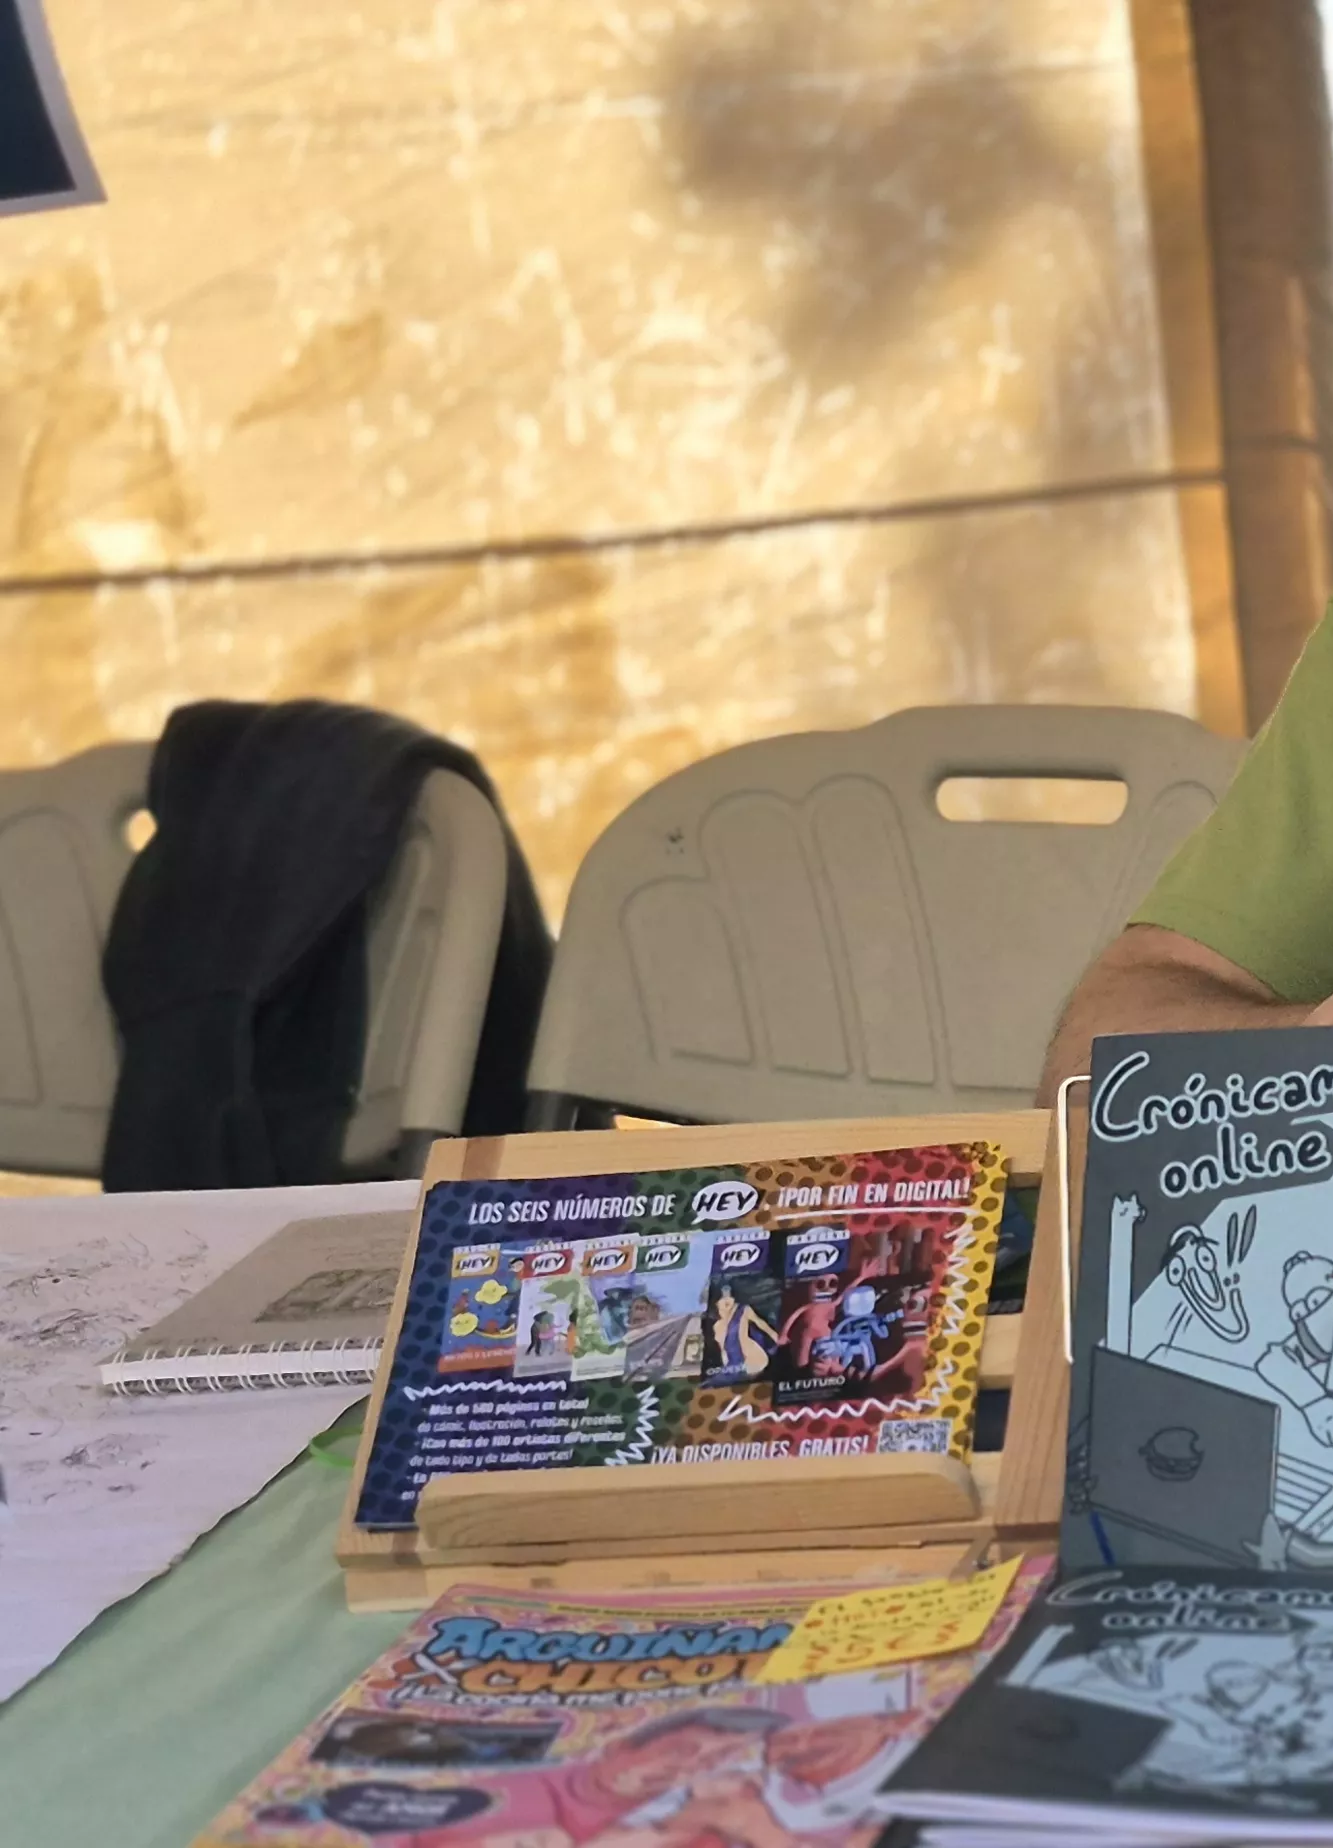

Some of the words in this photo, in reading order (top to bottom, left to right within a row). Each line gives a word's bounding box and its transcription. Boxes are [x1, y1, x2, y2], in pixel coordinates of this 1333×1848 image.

[1160, 1120, 1332, 1198] online
[468, 1202, 502, 1226] LOS
[507, 1200, 550, 1224] SEIS
[553, 1193, 648, 1222] NÚMEROS
[651, 1194, 676, 1217] DE
[777, 1184, 822, 1209] ¡POR
[828, 1182, 858, 1206] FIN
[864, 1182, 888, 1204] EN
[893, 1176, 971, 1203] DIGITAL!
[779, 1380, 792, 1392] EL
[798, 1434, 870, 1458] GRATIS!
